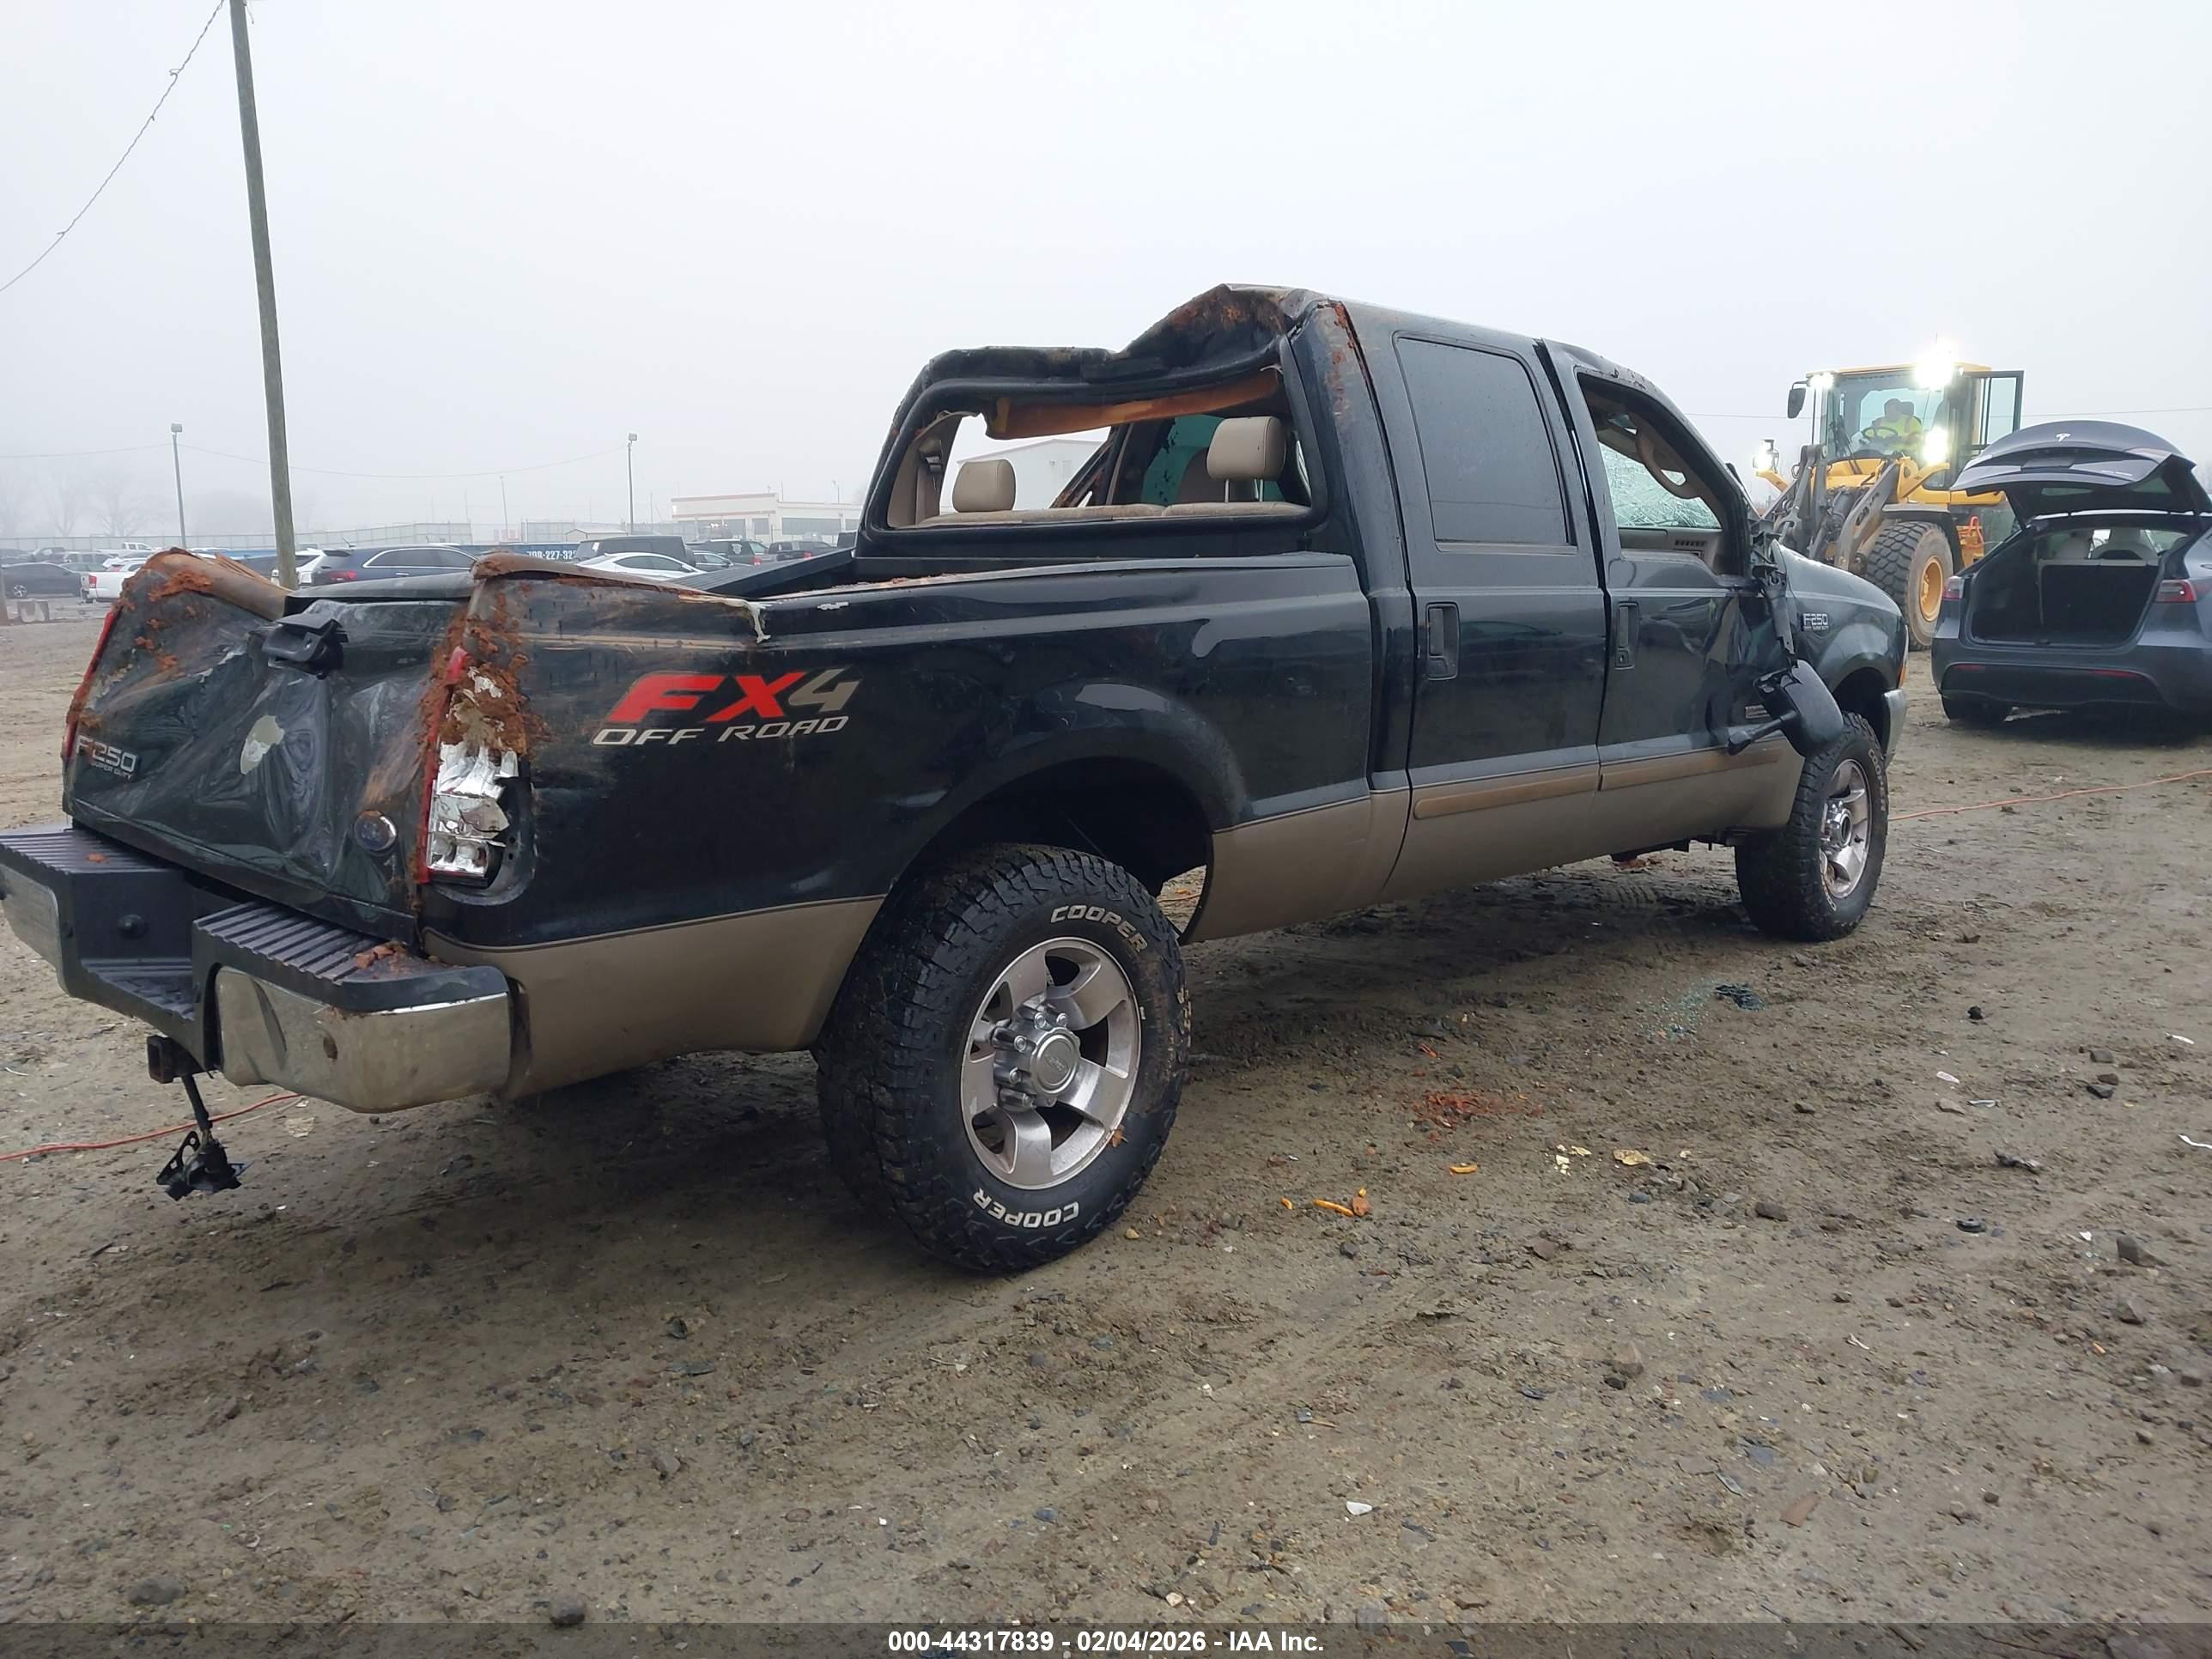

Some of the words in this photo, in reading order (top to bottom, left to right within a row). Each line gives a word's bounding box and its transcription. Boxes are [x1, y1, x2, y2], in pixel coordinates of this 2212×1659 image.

[1803, 613, 1828, 626] F250
[606, 667, 860, 723] FX4
[591, 726, 705, 746] OFF
[718, 715, 849, 743] ROAD
[76, 734, 137, 773] F250
[1050, 904, 1148, 953] COOPER
[973, 1187, 1079, 1229] COOPER
